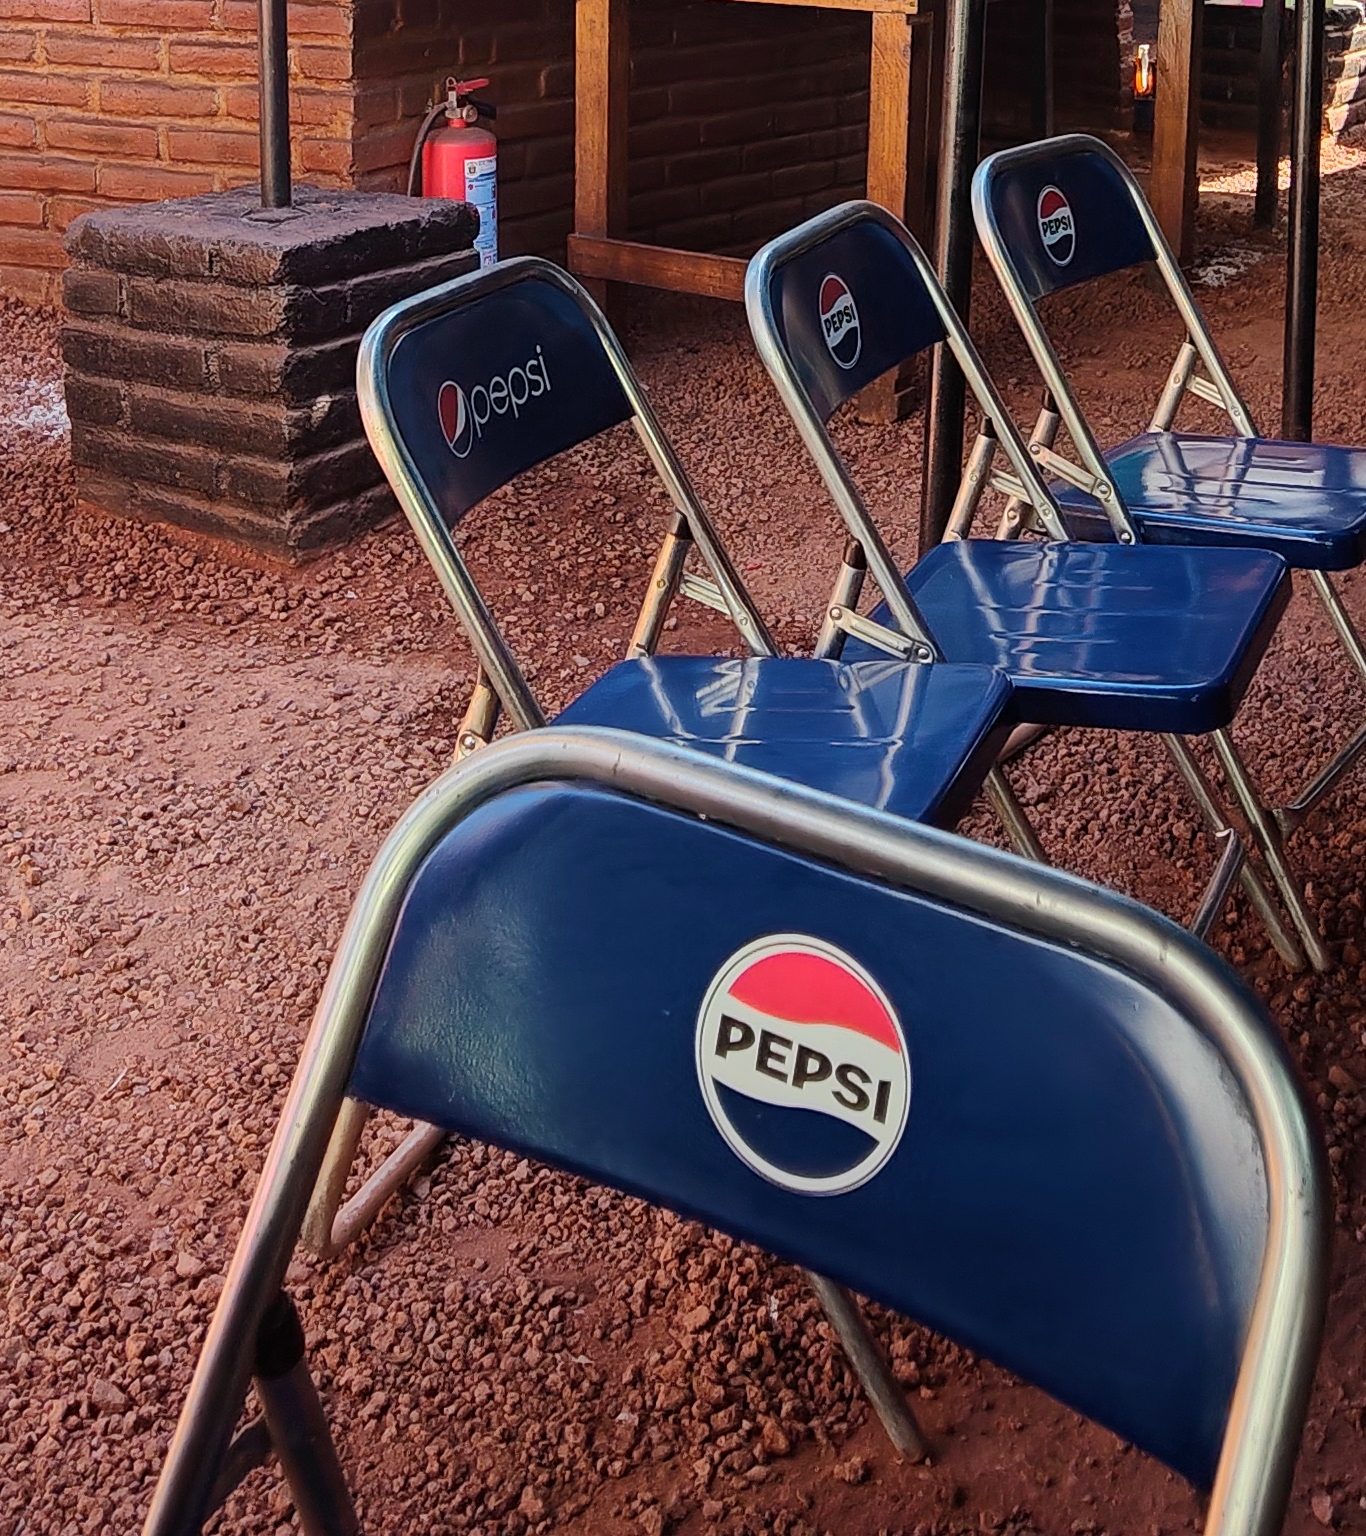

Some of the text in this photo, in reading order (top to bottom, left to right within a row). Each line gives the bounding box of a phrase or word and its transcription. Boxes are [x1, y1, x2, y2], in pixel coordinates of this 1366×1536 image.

[1041, 214, 1072, 238] PEPSI
[823, 303, 856, 338] PEPSI
[470, 344, 552, 439] pepsi
[714, 1012, 893, 1127] PEPSI
